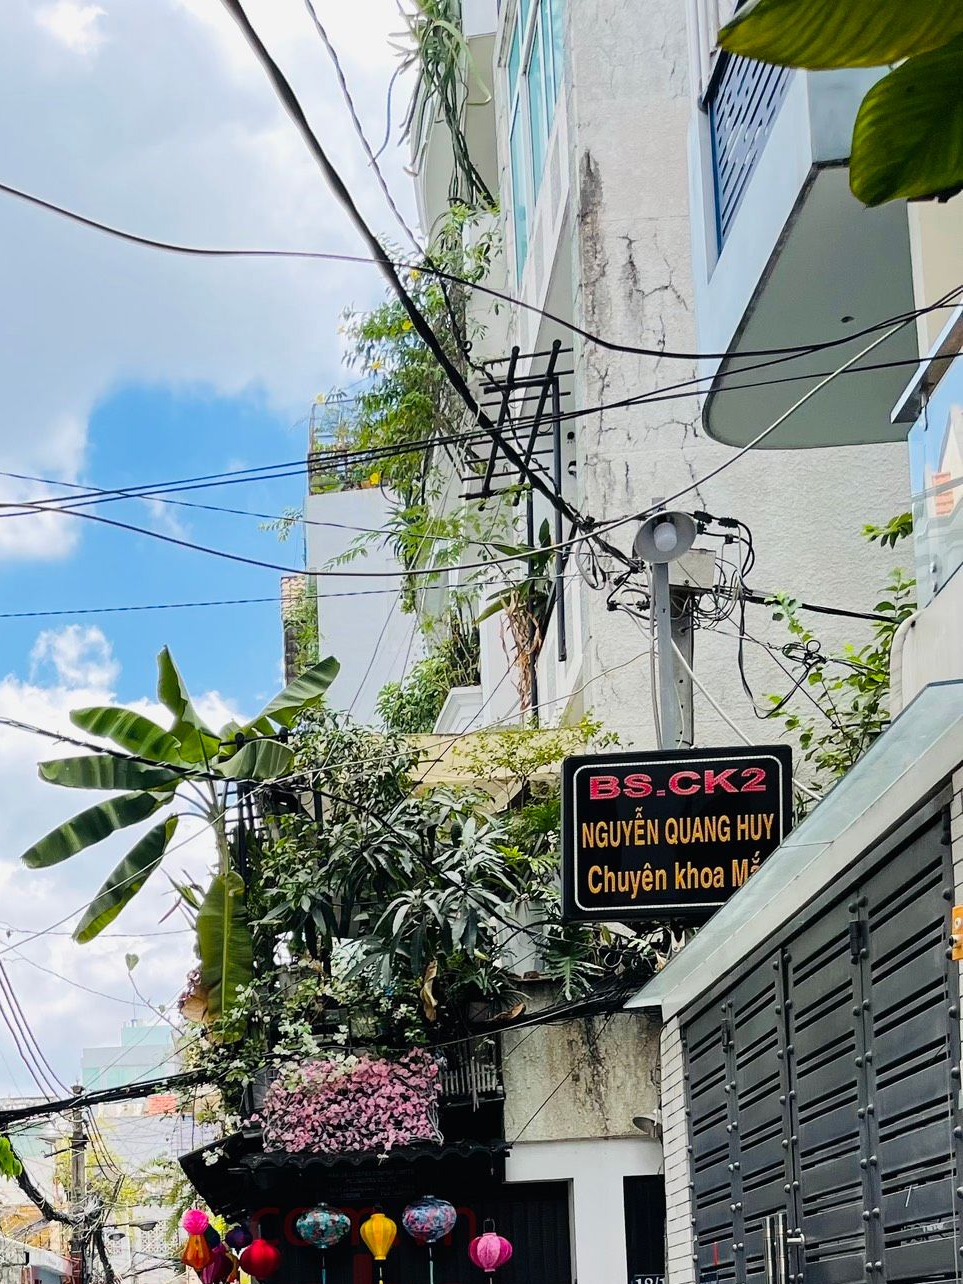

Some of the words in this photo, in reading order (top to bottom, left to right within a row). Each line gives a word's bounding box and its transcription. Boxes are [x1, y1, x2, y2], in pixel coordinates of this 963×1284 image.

[581, 806, 659, 849] NGUYỄN
[664, 815, 731, 846] QUANG
[737, 813, 775, 841] HUY
[587, 862, 667, 900] Chuyên
[674, 862, 725, 891] khoa
